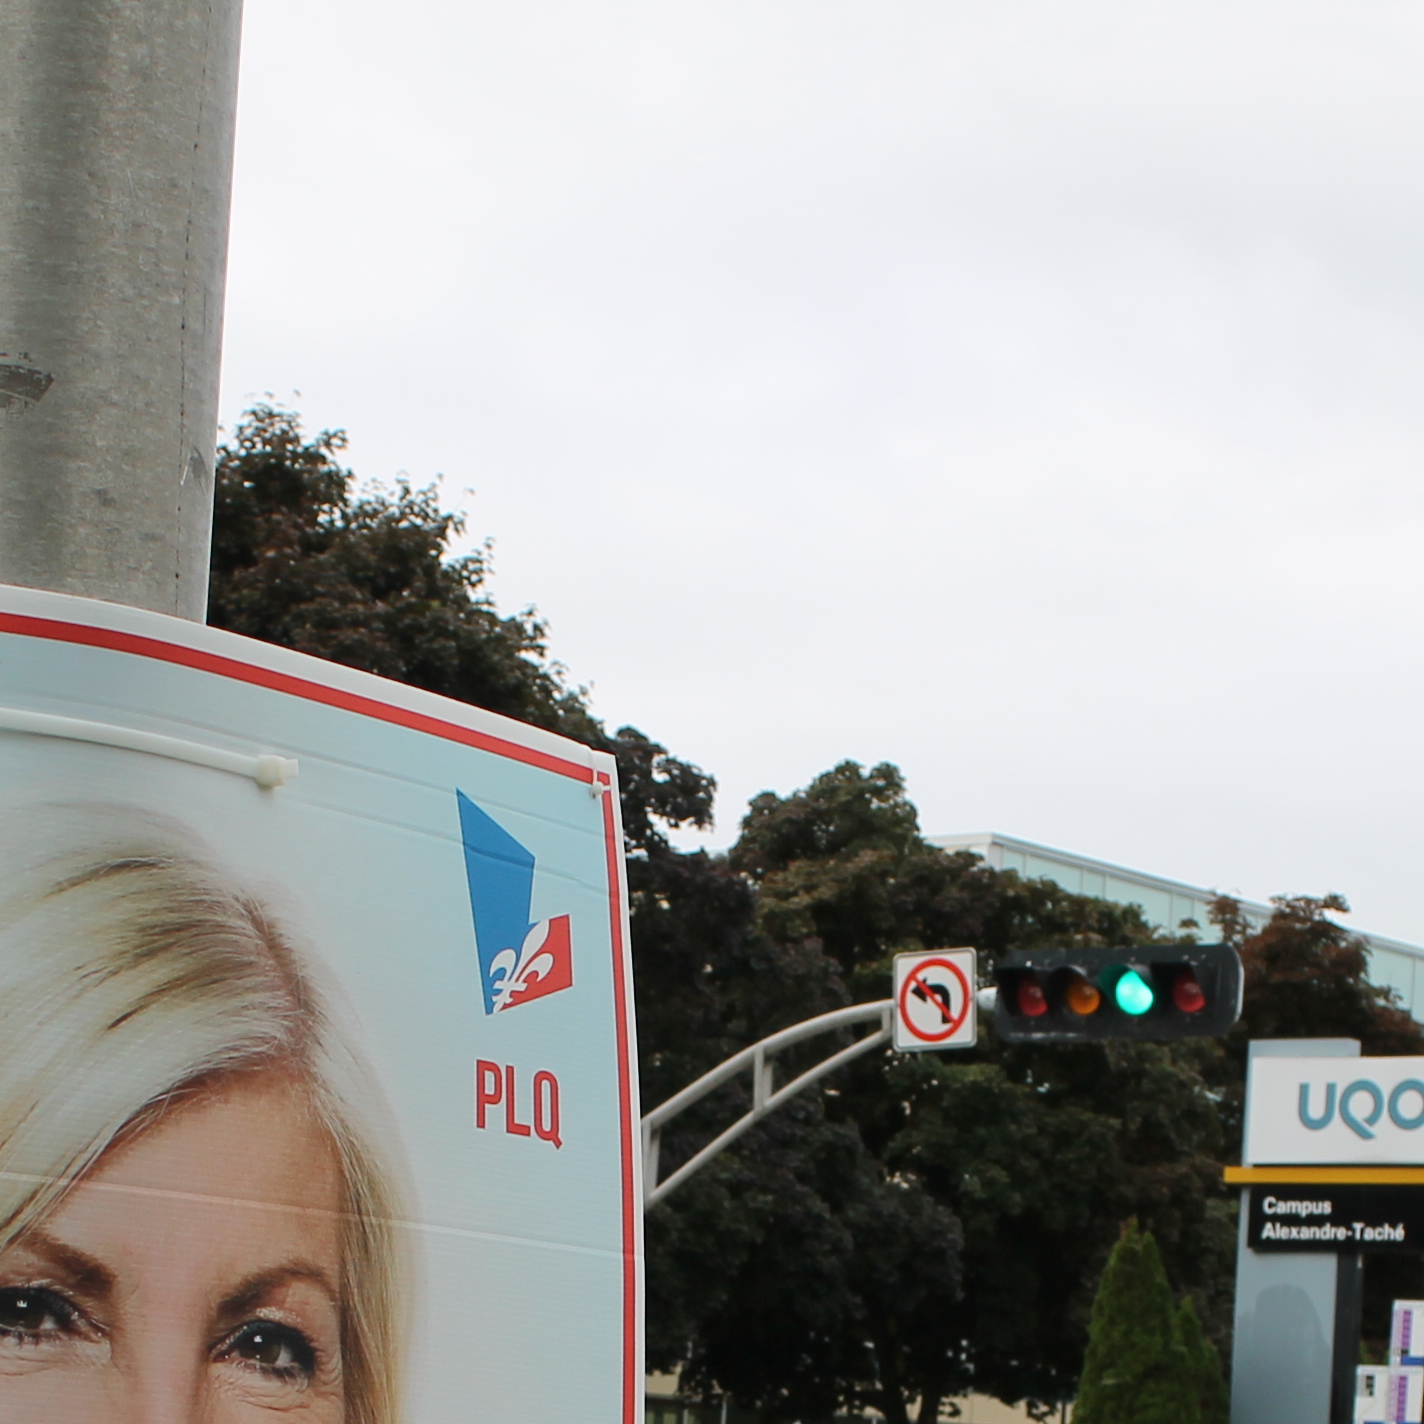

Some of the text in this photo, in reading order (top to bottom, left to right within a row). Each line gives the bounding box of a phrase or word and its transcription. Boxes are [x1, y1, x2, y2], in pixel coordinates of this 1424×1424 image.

[475, 1059, 563, 1149] PLQ
[1262, 1196, 1333, 1217] Campus
[1261, 1222, 1406, 1242] Alexandre-Taché
